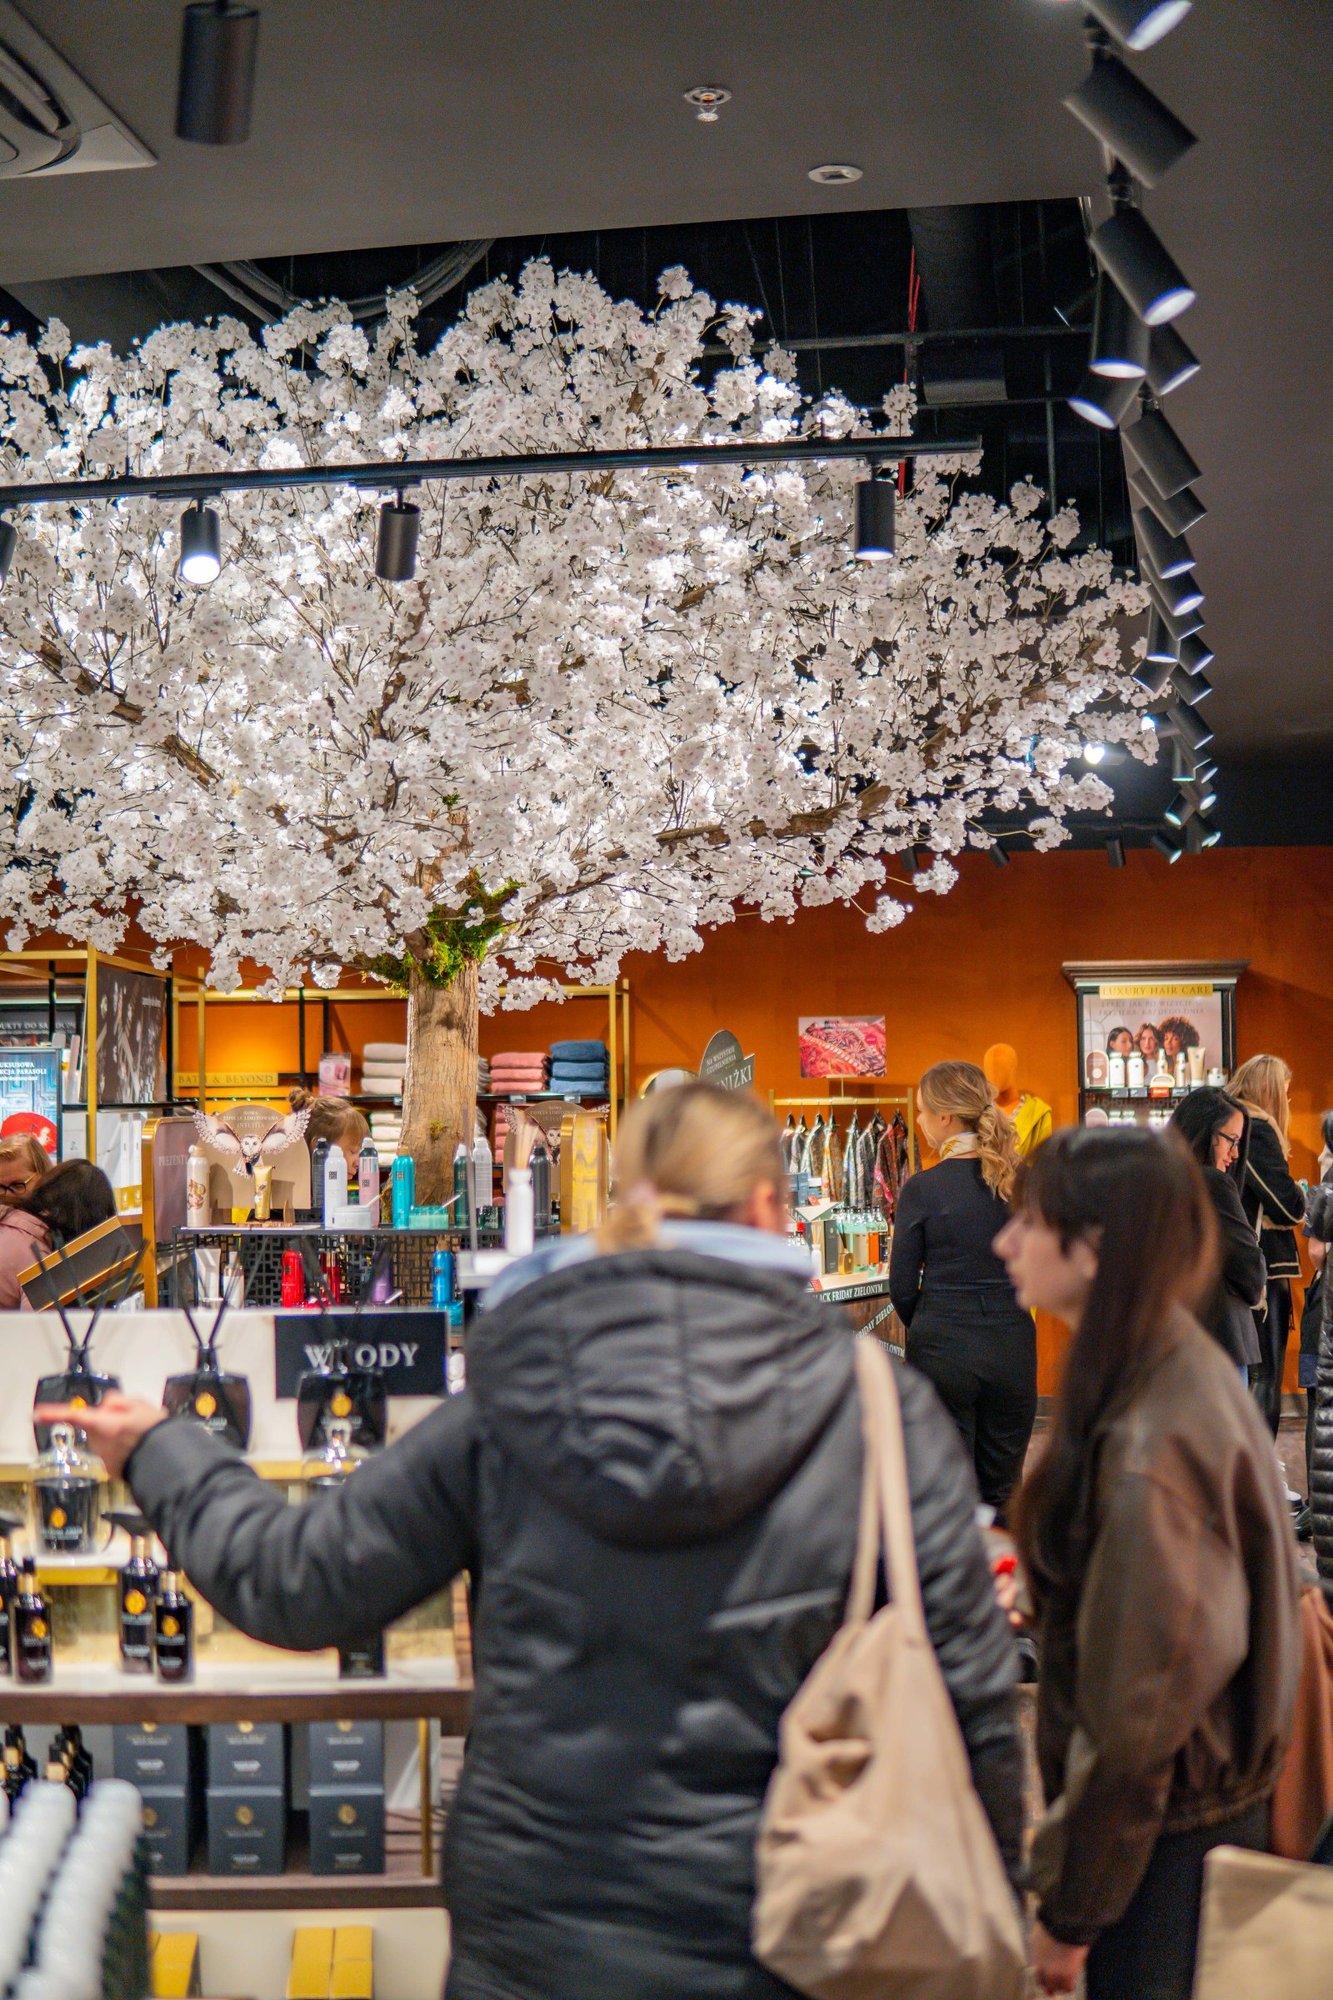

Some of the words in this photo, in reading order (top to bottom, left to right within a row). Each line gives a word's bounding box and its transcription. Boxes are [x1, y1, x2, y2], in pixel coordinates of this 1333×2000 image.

[1103, 987, 1146, 995] LUXURY
[1150, 986, 1177, 995] HAIR
[1181, 985, 1209, 994] CARE
[226, 1075, 274, 1084] BEYOND
[716, 1065, 752, 1090] NIŻKI
[832, 1289, 853, 1302] FRIDAY
[854, 1283, 883, 1297] ZIELONYM
[304, 1343, 419, 1368] WODY
